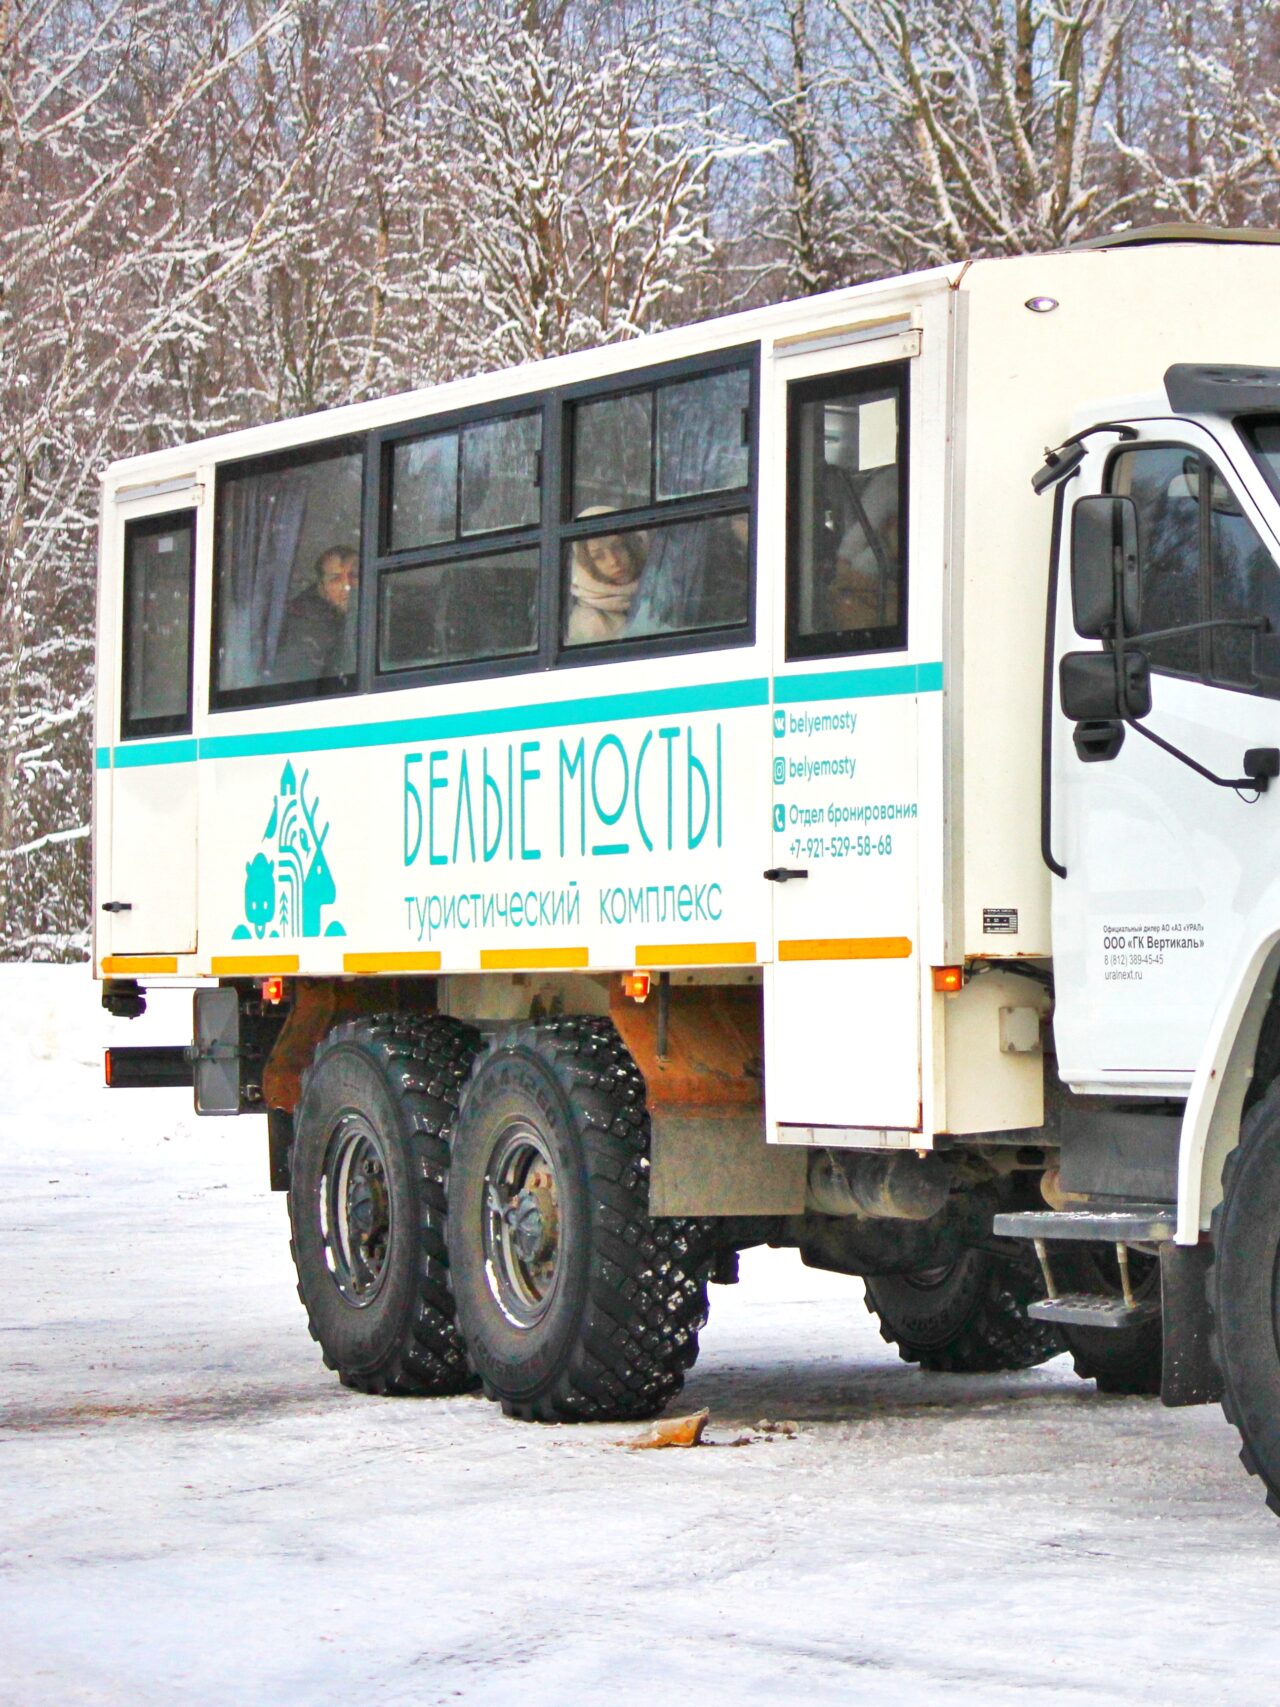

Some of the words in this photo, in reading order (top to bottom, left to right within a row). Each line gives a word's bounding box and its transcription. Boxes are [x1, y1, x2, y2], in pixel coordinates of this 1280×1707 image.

[789, 711, 857, 737] belyemosty
[789, 755, 857, 782] belyemosty
[404, 741, 541, 867] БЕЛЫЕ
[559, 722, 722, 858] МОСТЫ
[789, 804, 824, 827] Отдел
[827, 802, 918, 828] бронирования
[789, 834, 893, 859] +7-921-529-58-68
[404, 880, 580, 942] туристический
[600, 882, 722, 925] комплекс
[1103, 936, 1126, 949] ООО
[1127, 936, 1145, 949] «ГК
[1146, 935, 1204, 951] Вертикаль»
[1104, 954, 1109, 966] 8
[1110, 954, 1128, 967] (812)
[1129, 954, 1164, 965] 389-45-45
[1104, 969, 1143, 980] uralnext.ru
